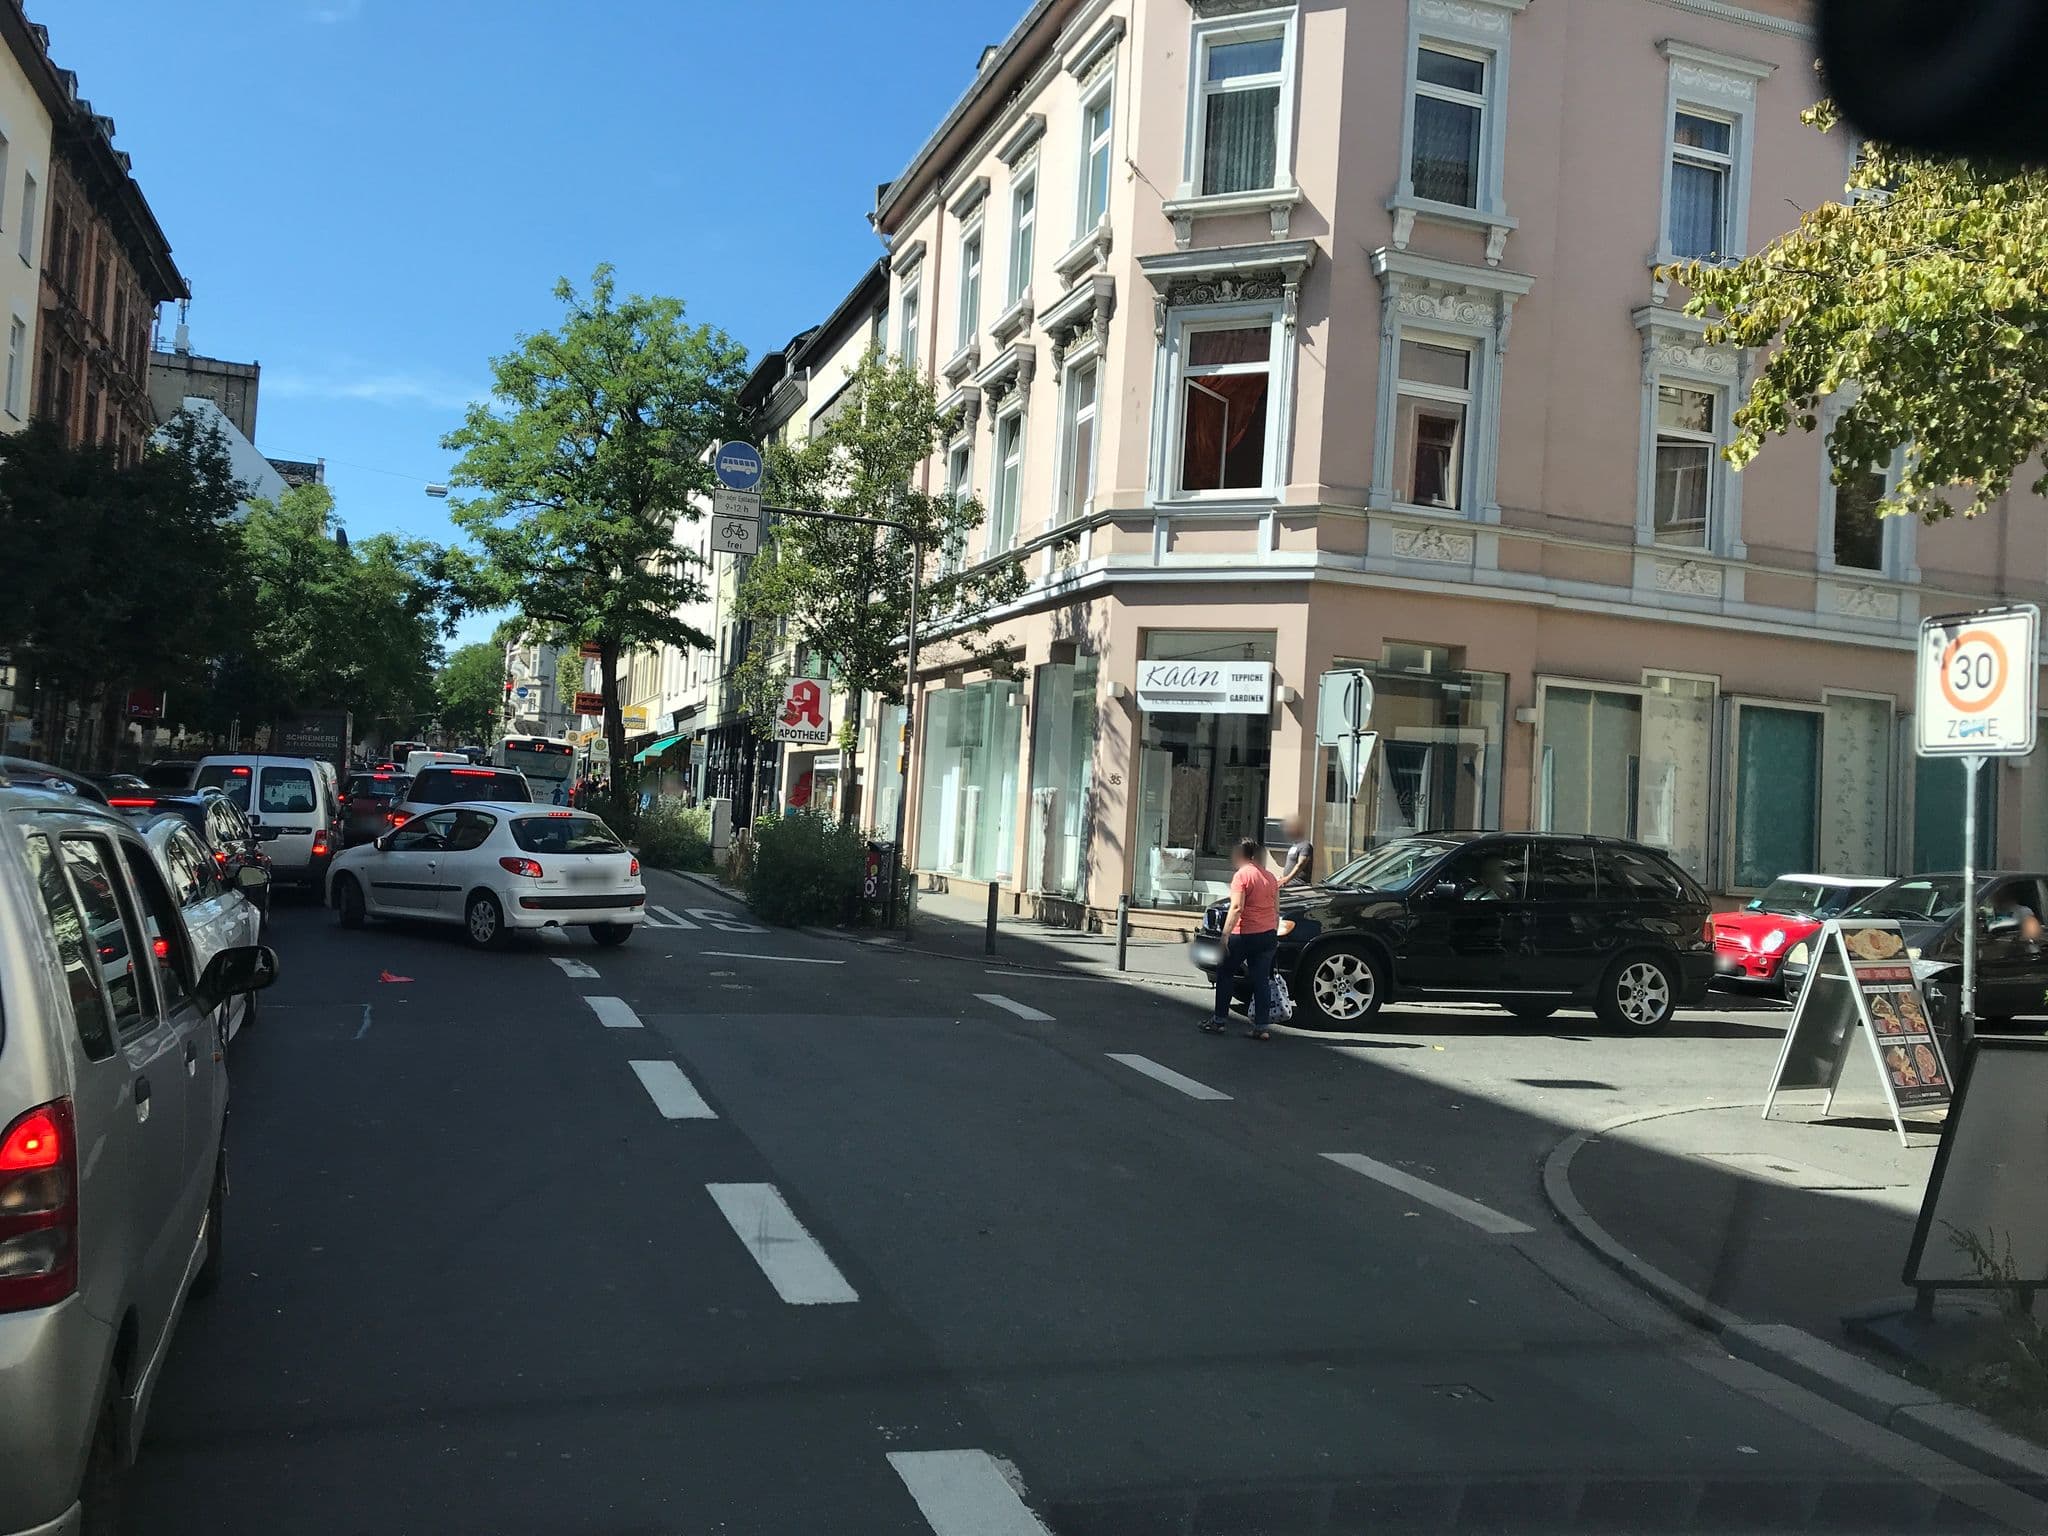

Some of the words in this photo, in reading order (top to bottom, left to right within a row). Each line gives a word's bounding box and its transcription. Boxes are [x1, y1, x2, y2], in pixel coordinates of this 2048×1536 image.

[727, 540, 742, 550] frei
[1955, 653, 1992, 690] 30
[1231, 673, 1264, 682] TEPPICHE
[1229, 694, 1264, 702] GARDINEN
[778, 728, 825, 741] APOTHEKE
[535, 744, 545, 752] 17
[1108, 775, 1122, 785] 35
